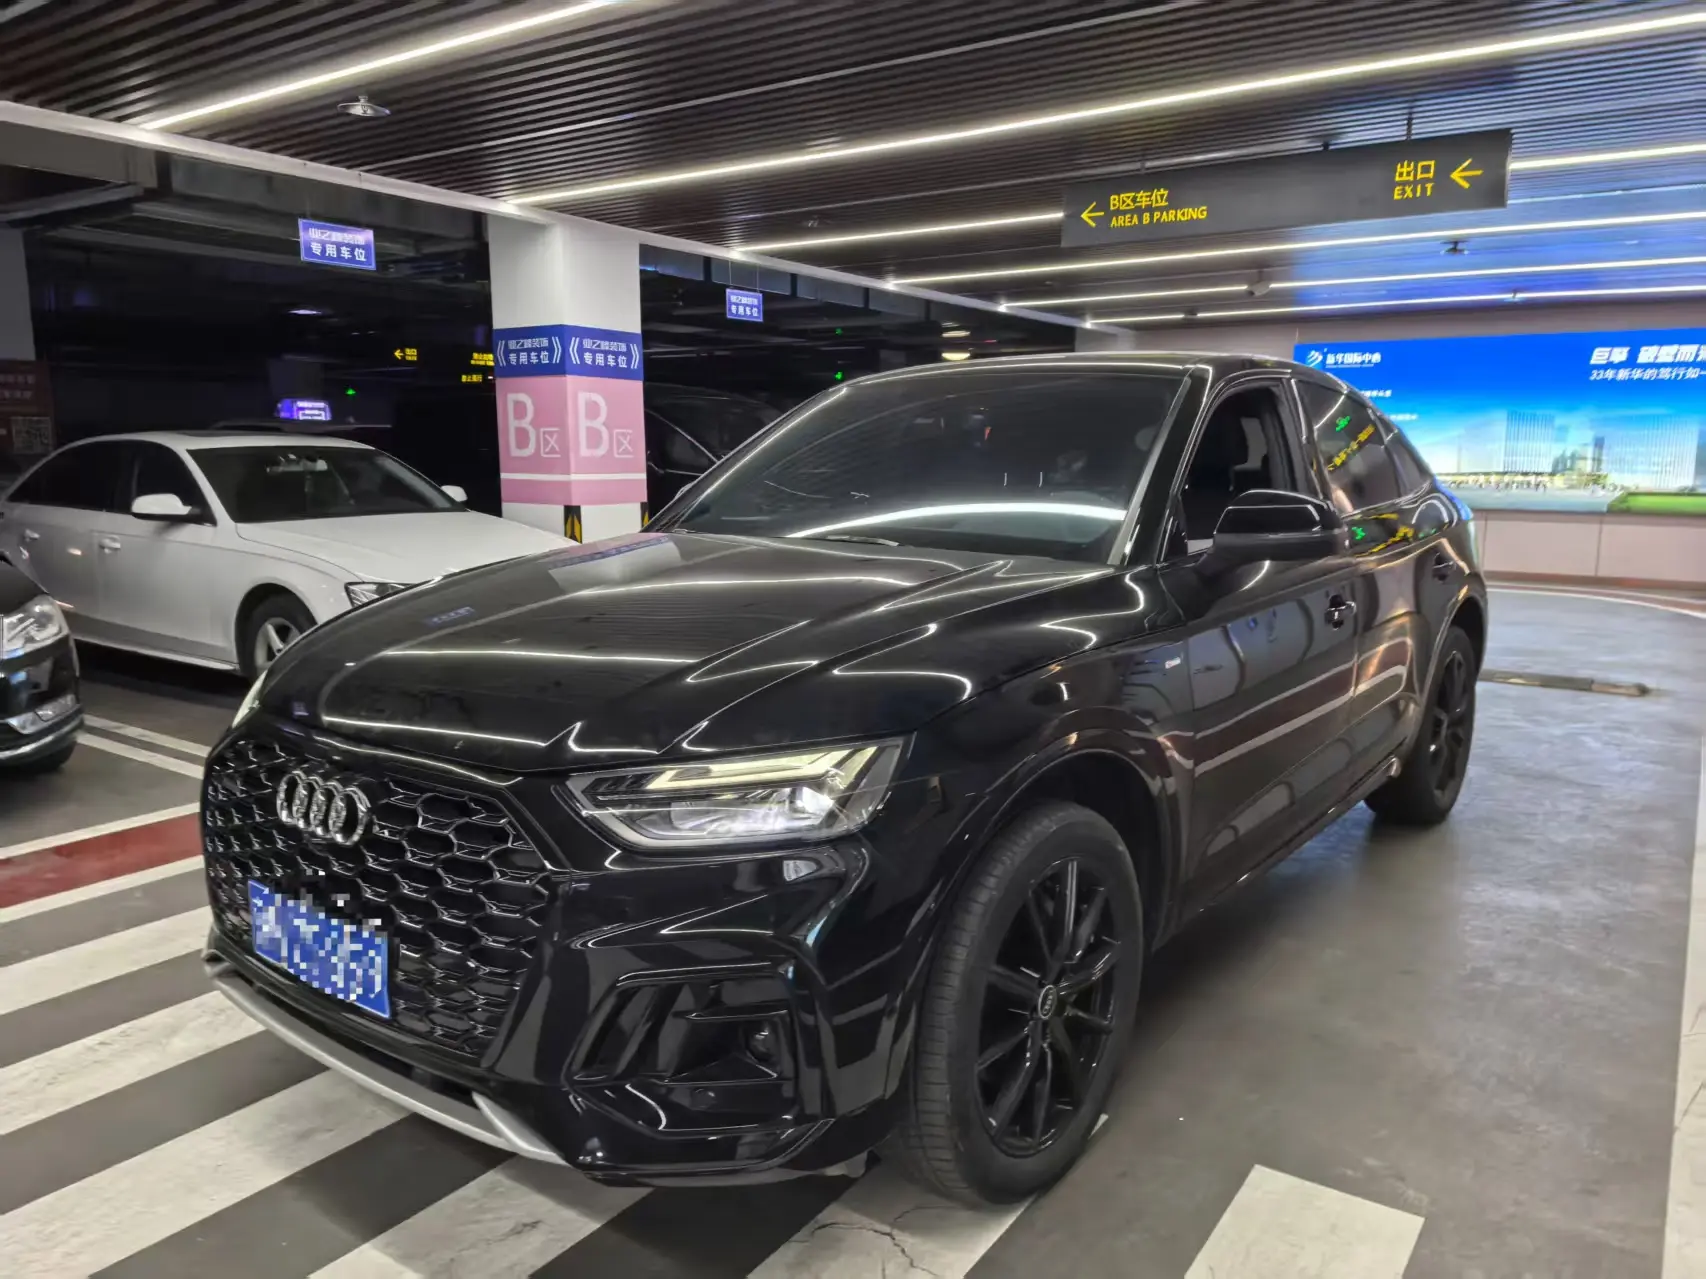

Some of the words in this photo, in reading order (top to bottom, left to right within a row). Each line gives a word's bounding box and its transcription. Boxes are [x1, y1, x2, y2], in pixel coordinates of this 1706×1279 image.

[1395, 160, 1435, 182] 出口
[1110, 188, 1169, 210] B区车位
[1393, 182, 1435, 200] EXIT
[1110, 214, 1138, 228] AREA
[1142, 212, 1150, 225] B
[1153, 206, 1207, 223] PARKING
[310, 241, 367, 261] 专用车位
[508, 351, 550, 365] 专用车位
[583, 352, 628, 369] 专用车位
[506, 392, 562, 458] B区
[577, 391, 635, 459] B区
